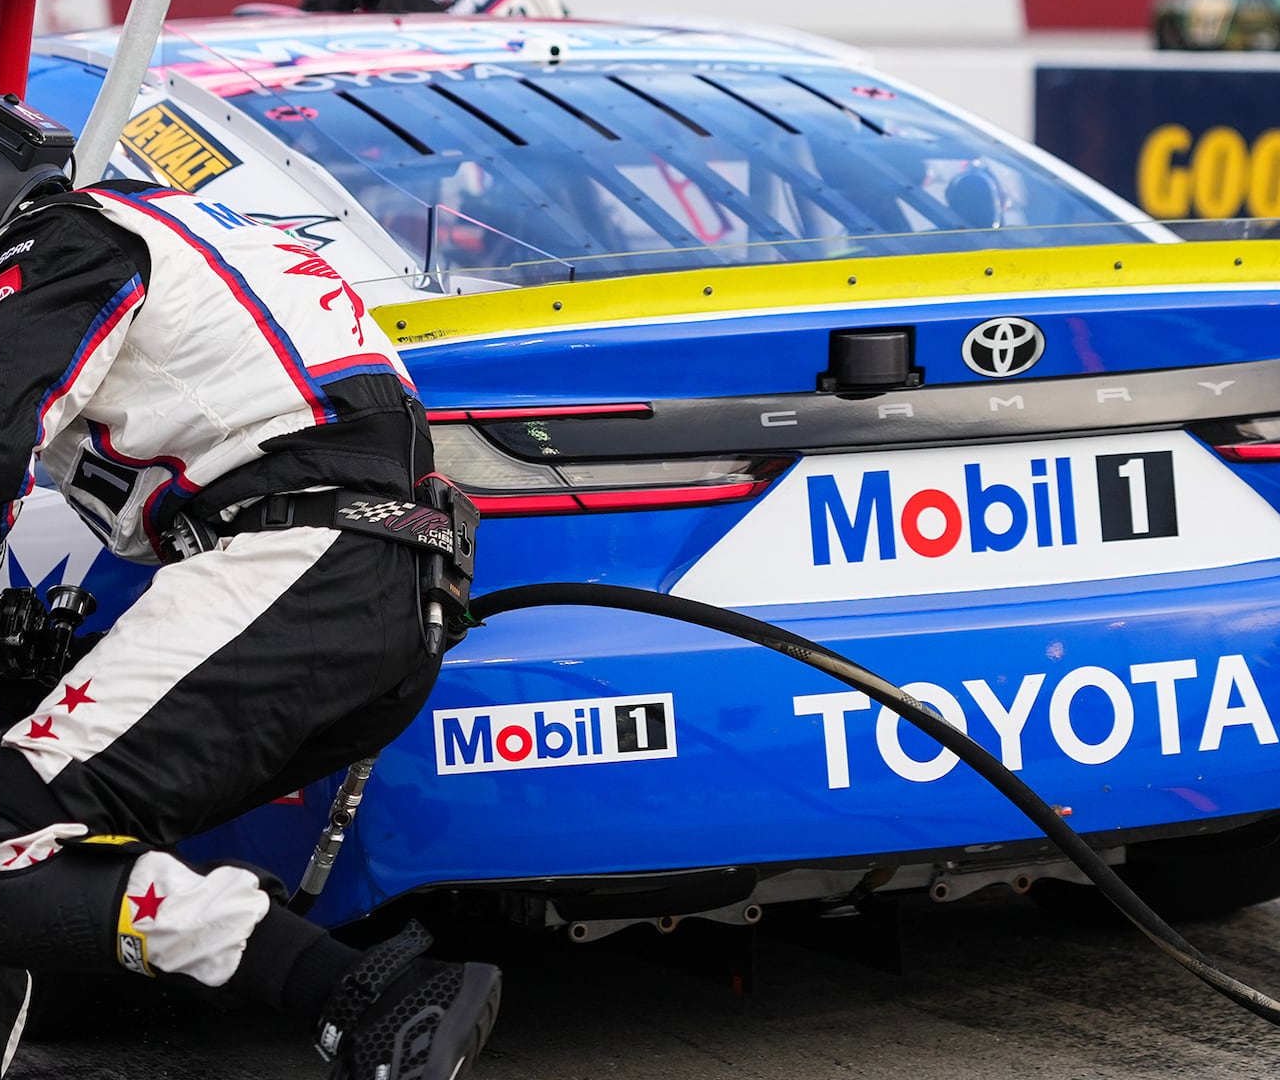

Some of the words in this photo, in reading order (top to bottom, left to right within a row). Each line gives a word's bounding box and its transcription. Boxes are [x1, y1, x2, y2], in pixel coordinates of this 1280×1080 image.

[760, 380, 1236, 428] CAMRY
[806, 457, 1078, 567] Mobil
[1117, 458, 1152, 536] 1
[442, 707, 602, 766] Mobil
[628, 706, 649, 749] 1
[792, 654, 1280, 789] TOYOTA
